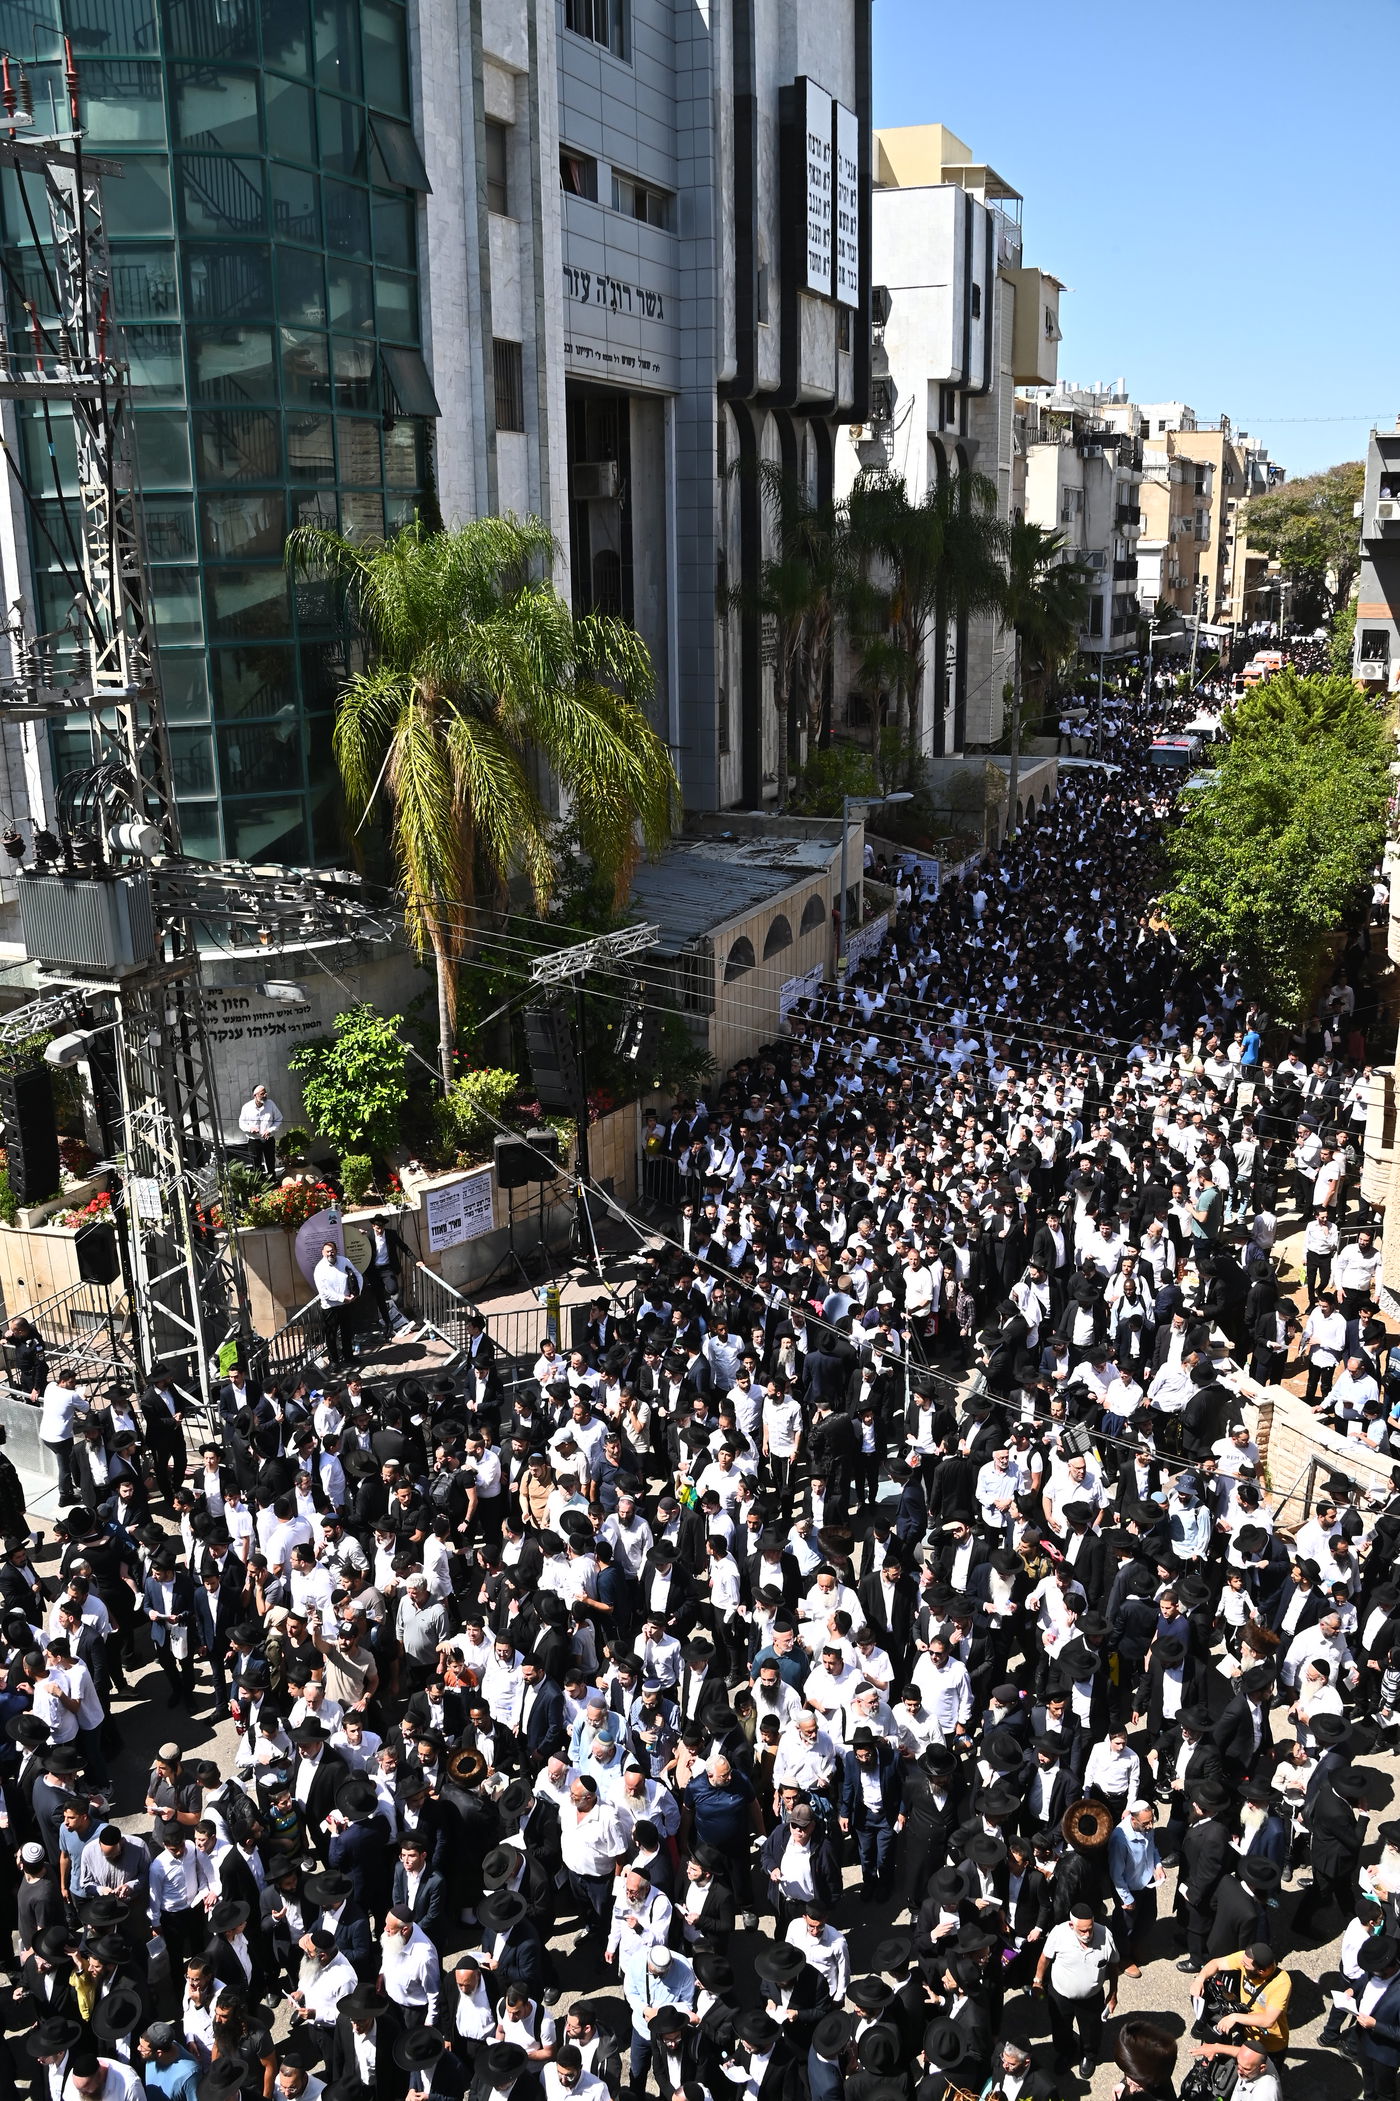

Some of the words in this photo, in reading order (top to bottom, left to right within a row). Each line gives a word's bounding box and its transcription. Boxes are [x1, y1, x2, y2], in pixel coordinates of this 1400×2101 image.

[823, 143, 830, 163] לא
[823, 172, 830, 192] לא
[850, 188, 856, 209] לא
[823, 200, 830, 220] לא
[850, 216, 856, 236] לא
[823, 228, 830, 248] לא
[823, 256, 830, 278] לא
[848, 270, 857, 291] כבד
[636, 288, 664, 320] גשר
[221, 998, 249, 1013] חזון
[294, 1004, 311, 1014] לזכר
[222, 1014, 251, 1024] והמעש
[253, 1012, 274, 1022] החזון
[247, 1022, 286, 1038] אליהו
